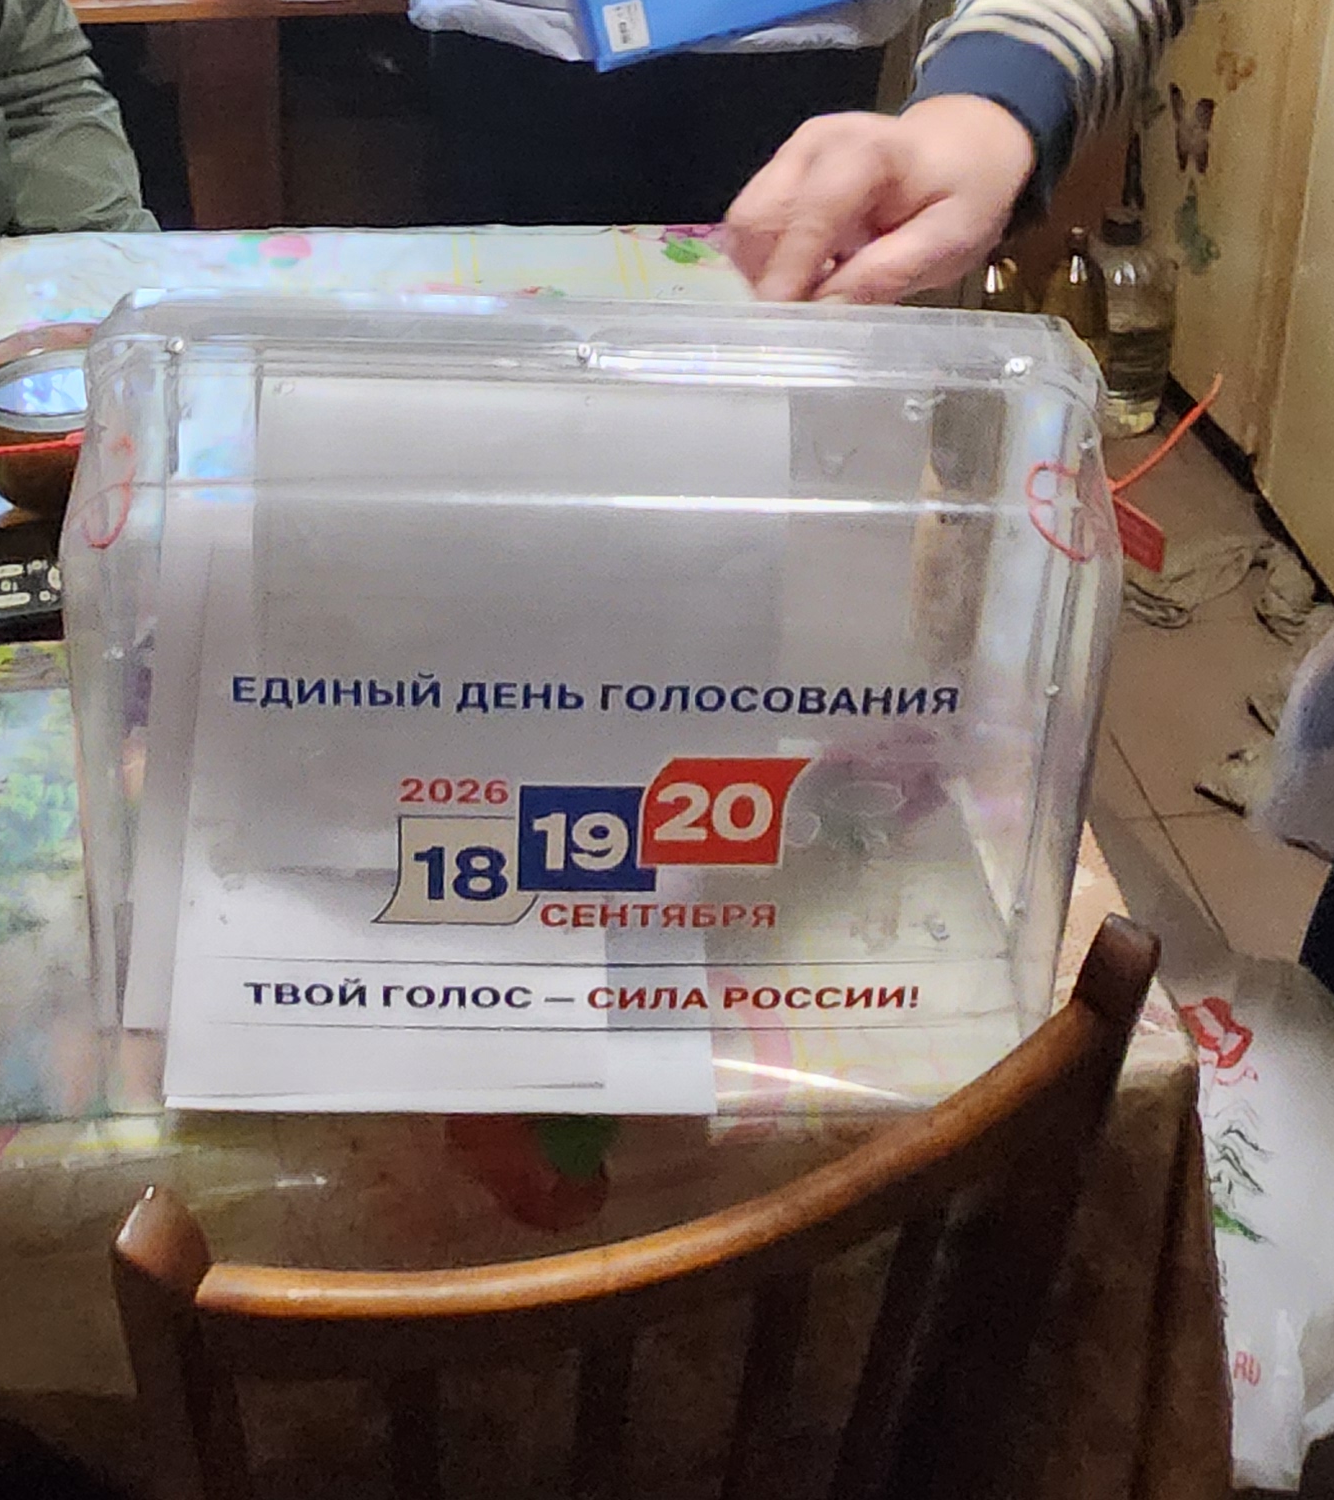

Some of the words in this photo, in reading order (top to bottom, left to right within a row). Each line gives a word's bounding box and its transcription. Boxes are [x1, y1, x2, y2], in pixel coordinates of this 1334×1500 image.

[233, 673, 440, 709] ЕДИНЫЙ
[457, 683, 583, 713] ДЕНЬ
[601, 685, 958, 716] ГОЛОСОВАНИЯ
[399, 778, 508, 805] 2026
[416, 849, 507, 898] 18
[533, 813, 628, 871] 19
[652, 782, 773, 841] 20
[540, 903, 775, 927] СЕНТЯБРЯ
[245, 979, 366, 1006] ТВОЙ
[383, 986, 530, 1008] ГОЛОС
[590, 988, 706, 1009] СИЛА
[723, 986, 917, 1011] РОССИИ!
